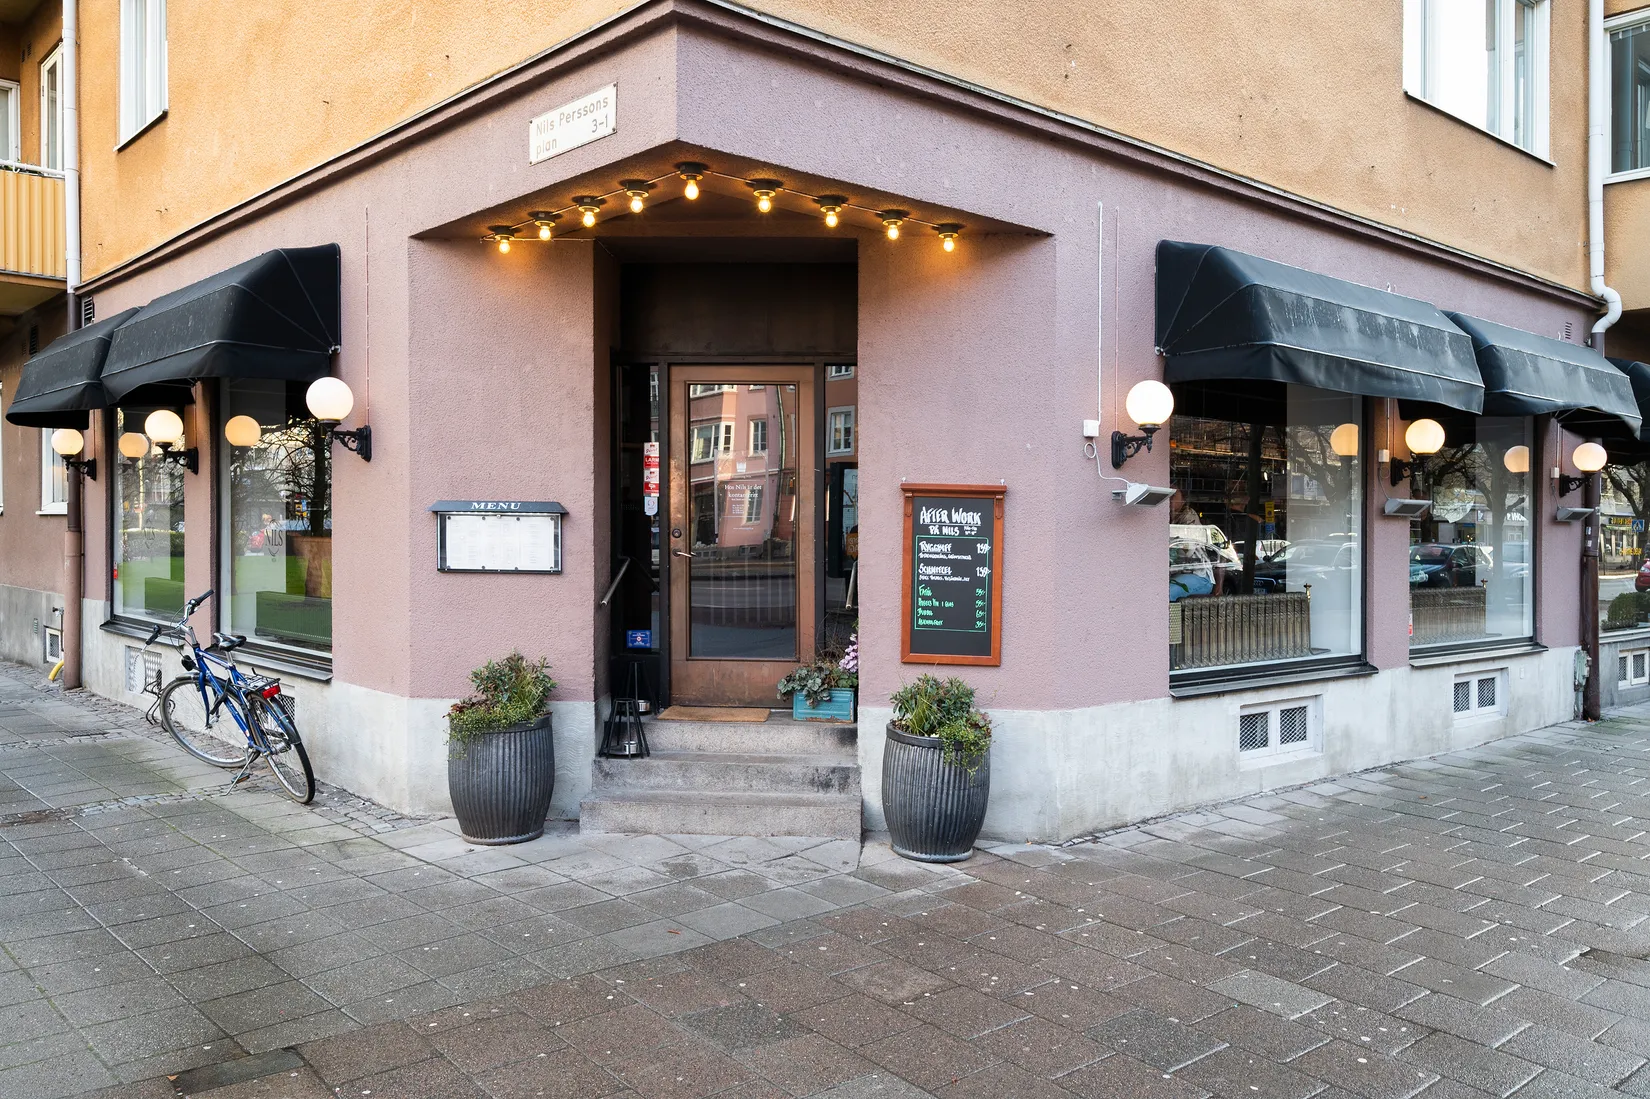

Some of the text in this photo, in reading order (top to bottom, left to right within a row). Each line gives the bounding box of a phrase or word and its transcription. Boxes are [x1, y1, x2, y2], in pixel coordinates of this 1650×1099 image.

[536, 96, 609, 136] Nils Perssons
[536, 114, 608, 159] plan 3-1
[470, 502, 521, 510] MENU
[920, 506, 981, 525] AFTER WORK
[265, 529, 284, 547] NILS
[942, 526, 960, 536] NILS
